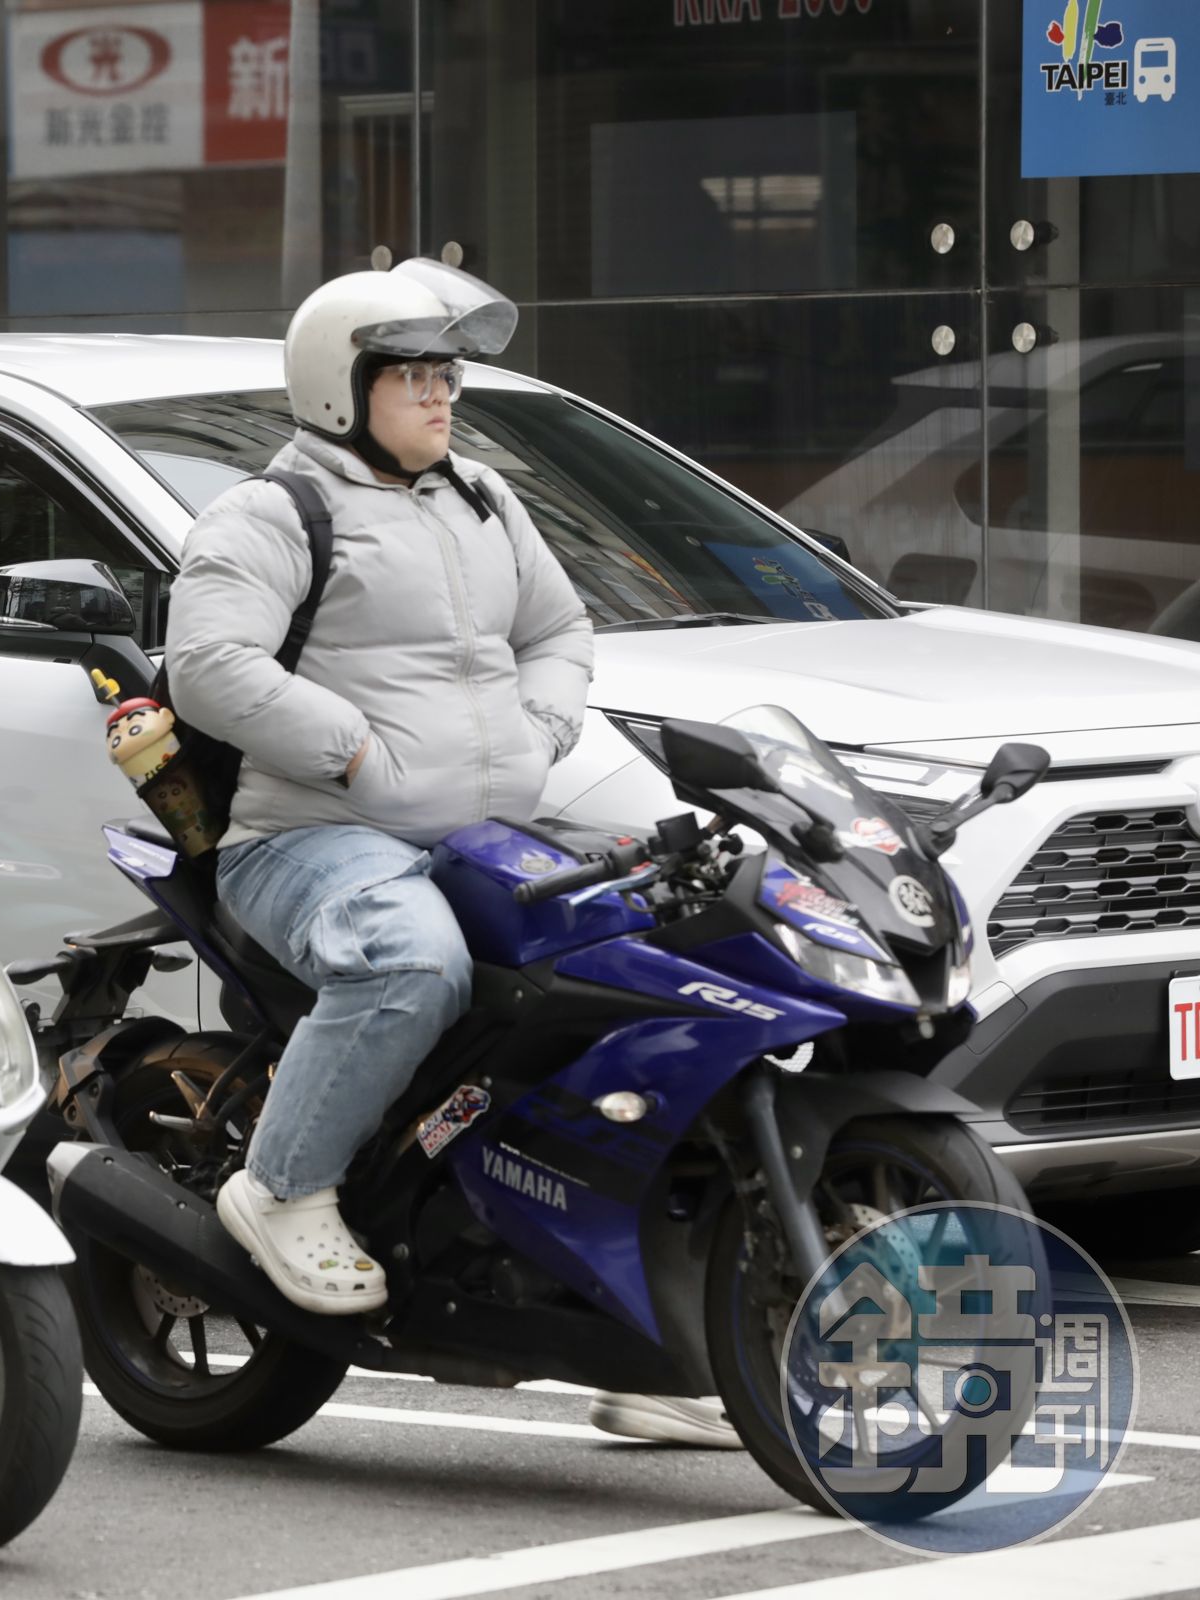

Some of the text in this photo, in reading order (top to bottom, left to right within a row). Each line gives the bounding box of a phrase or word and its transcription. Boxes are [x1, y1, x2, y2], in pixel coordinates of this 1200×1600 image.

[1041, 60, 1128, 91] TAIPEI
[1104, 92, 1127, 106] 臺北
[677, 981, 787, 1021] R15
[482, 1145, 567, 1211] YAMAHA
